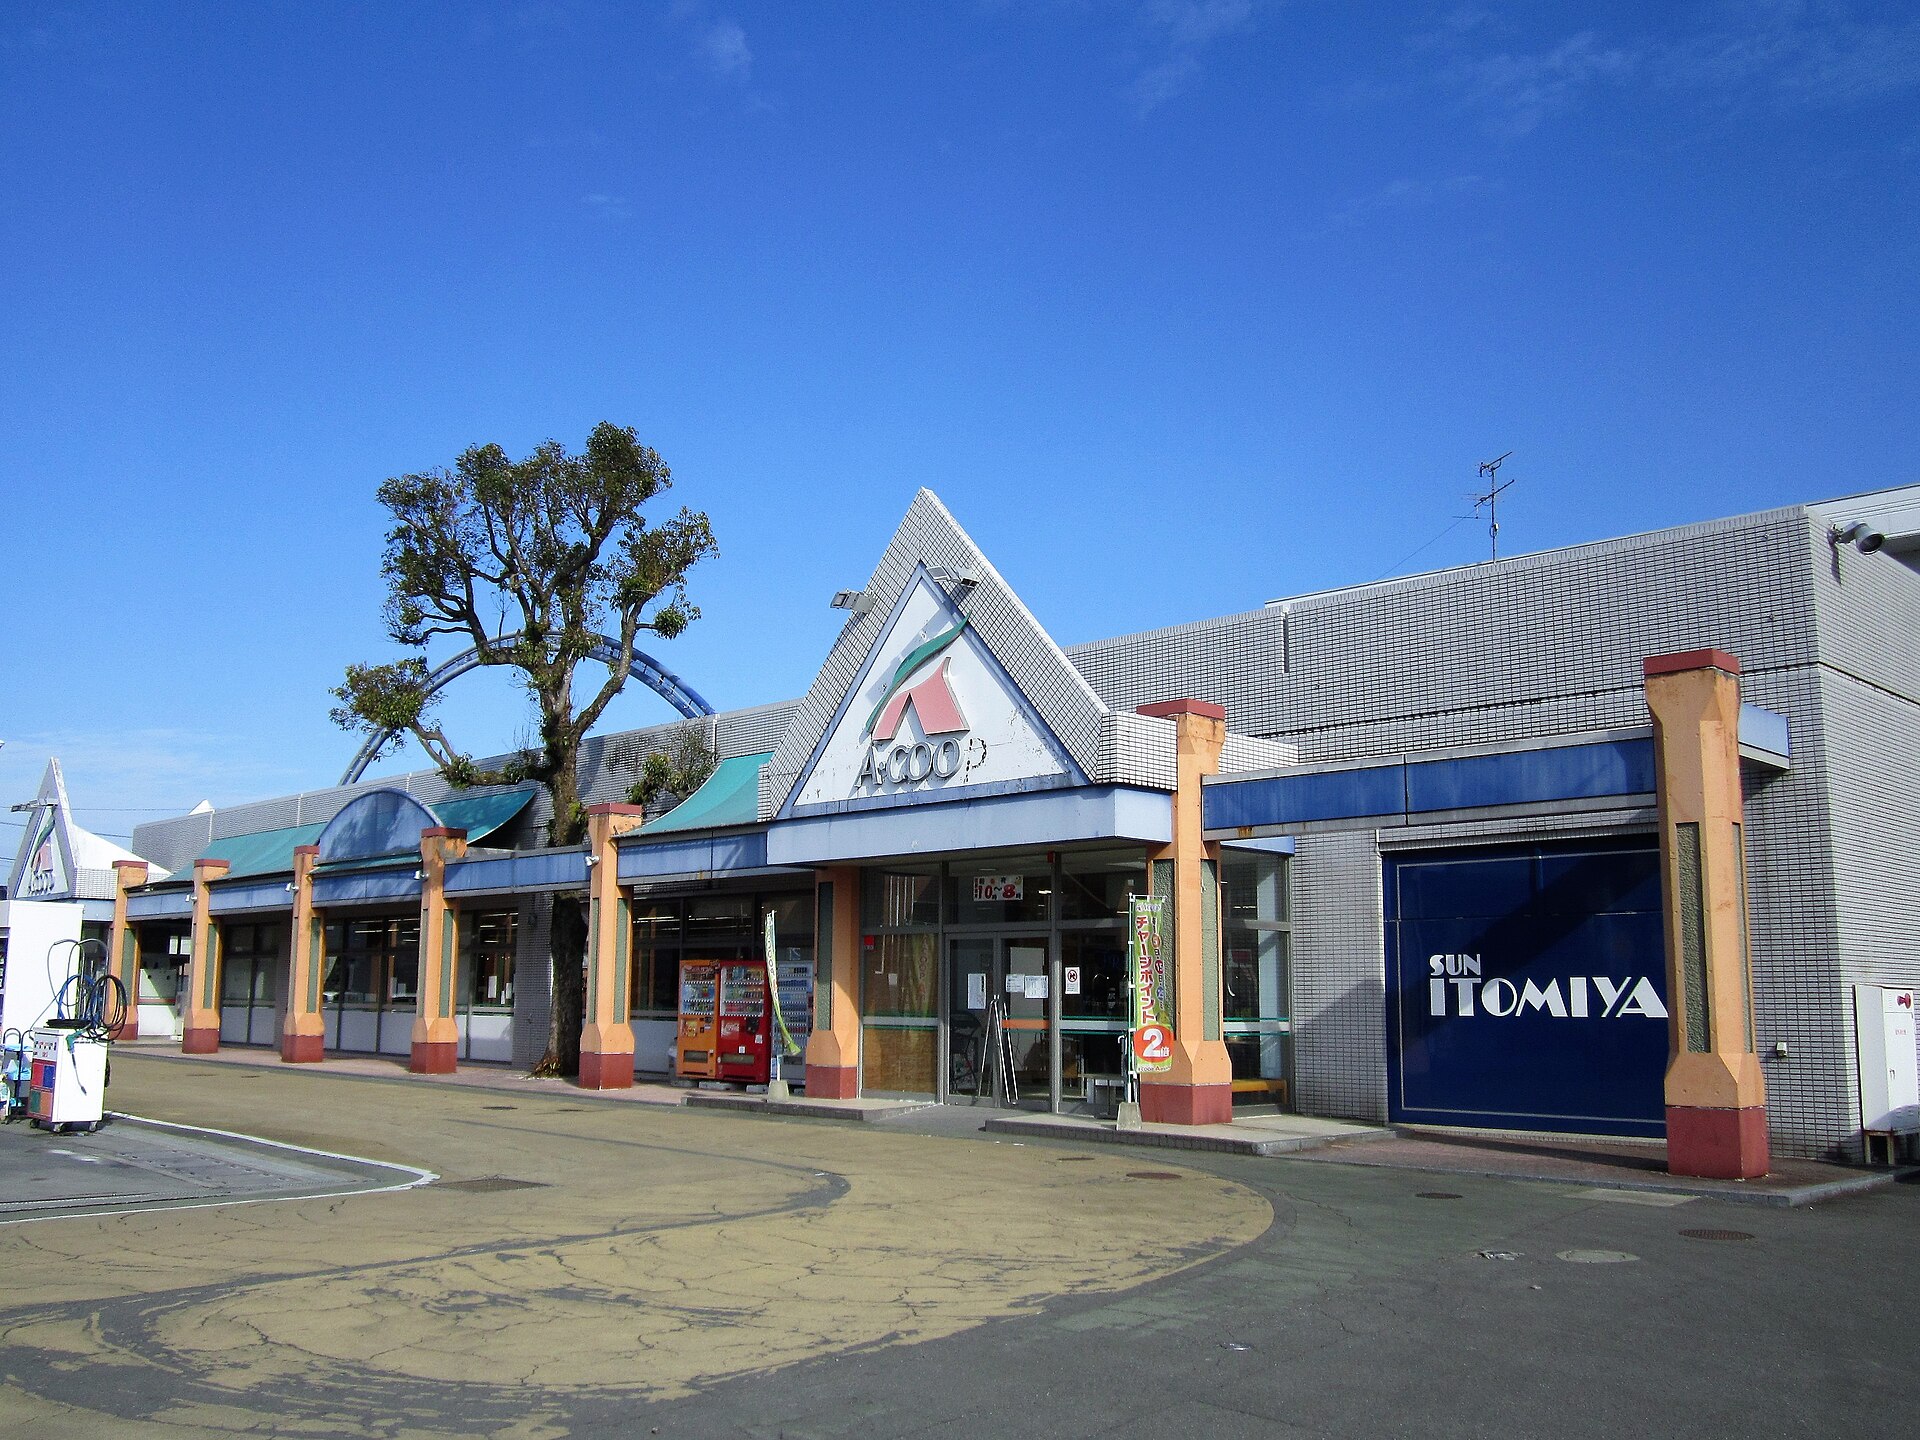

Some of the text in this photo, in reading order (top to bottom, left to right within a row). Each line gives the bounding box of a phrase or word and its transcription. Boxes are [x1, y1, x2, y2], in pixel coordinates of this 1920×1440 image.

[1136, 916, 1157, 1024] チャージポイント
[1429, 953, 1482, 976] SUN
[1429, 976, 1670, 1018] ITOMIYA
